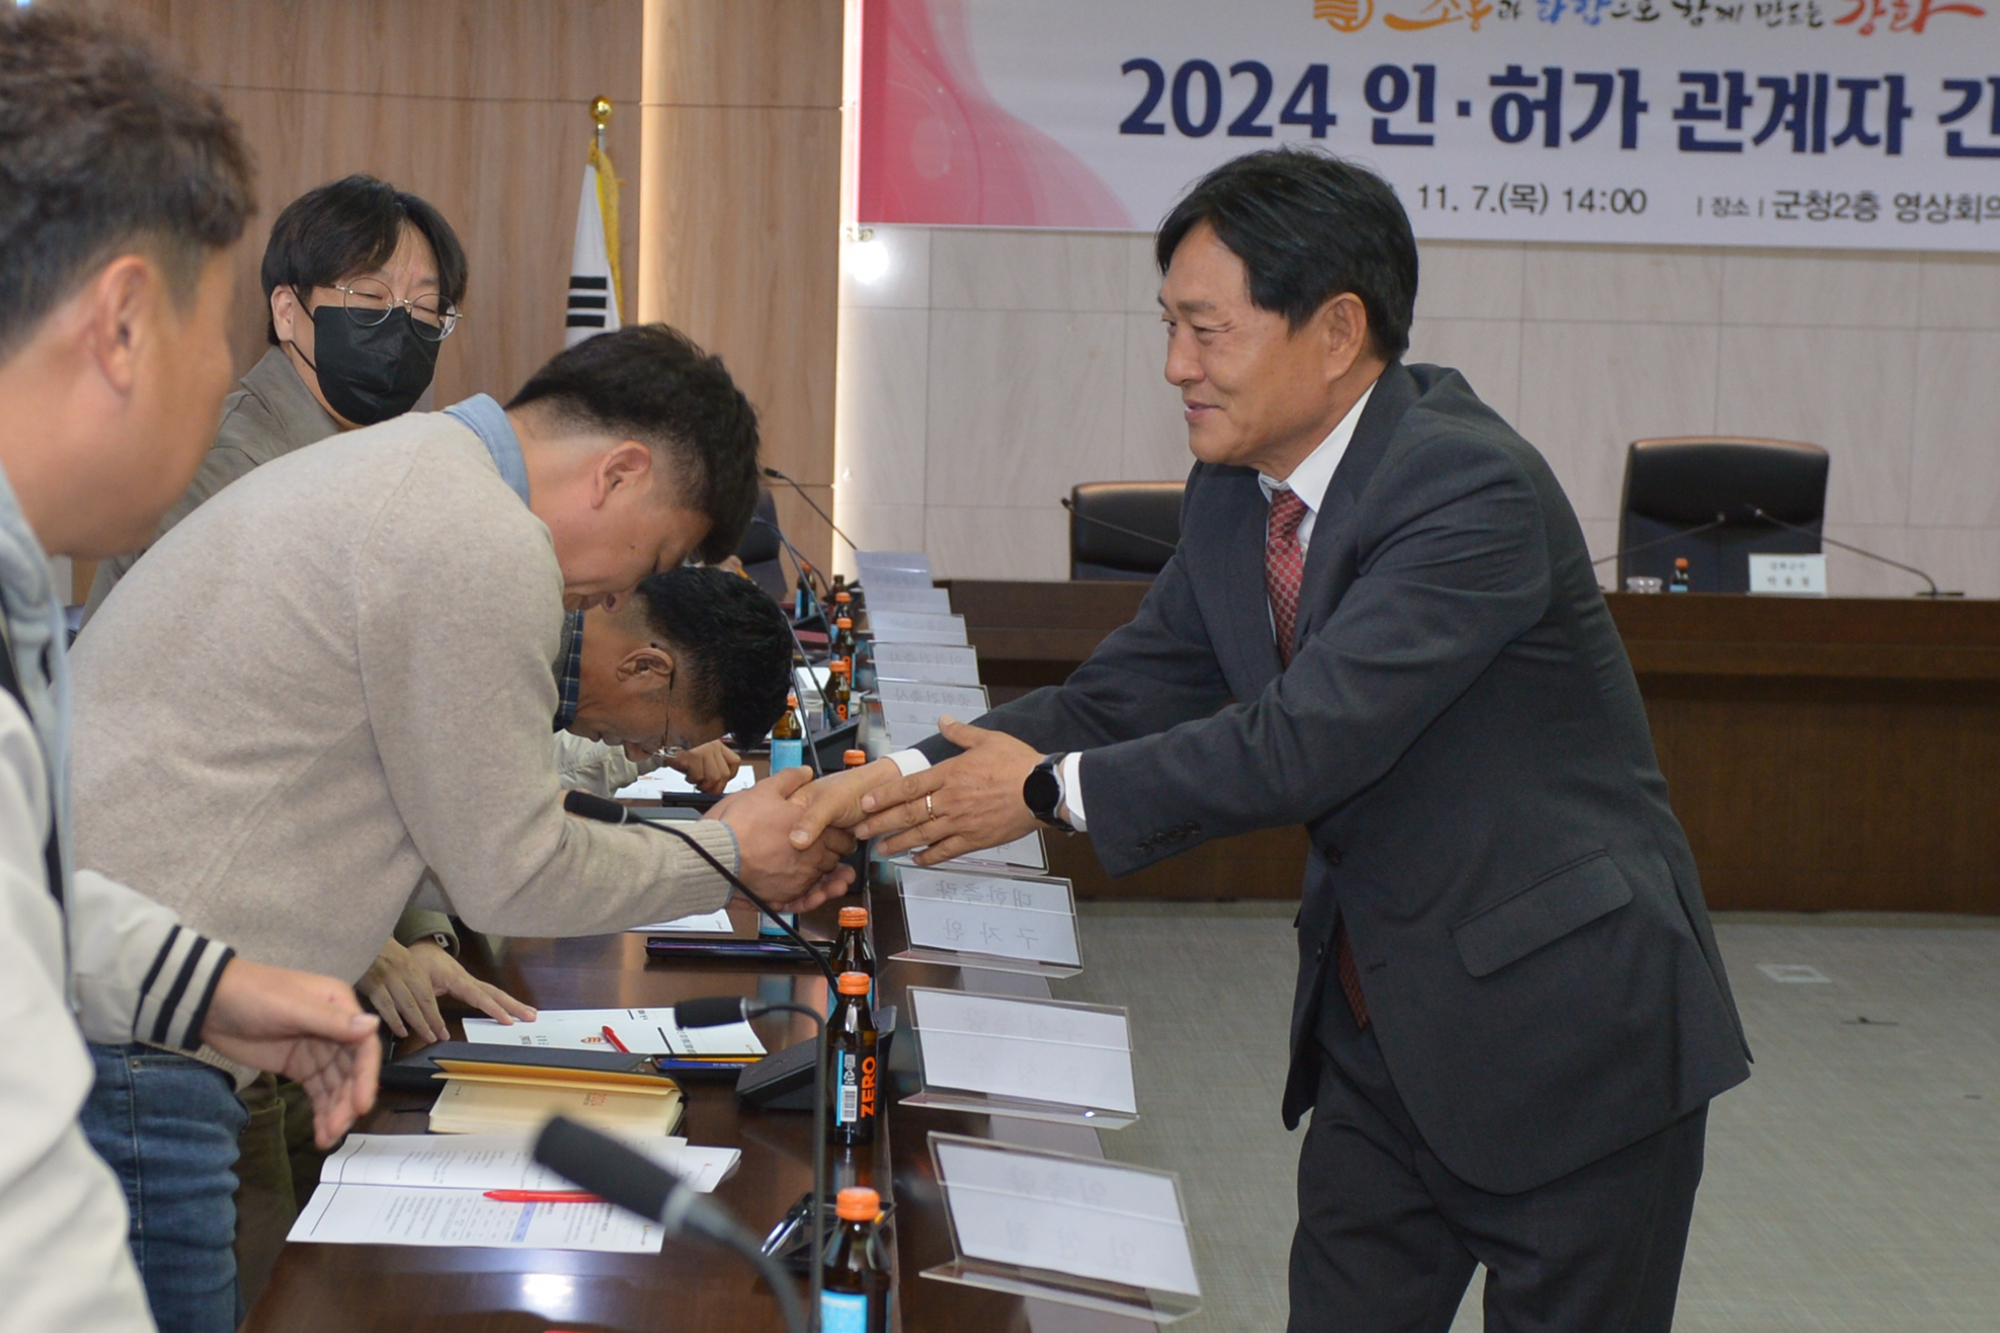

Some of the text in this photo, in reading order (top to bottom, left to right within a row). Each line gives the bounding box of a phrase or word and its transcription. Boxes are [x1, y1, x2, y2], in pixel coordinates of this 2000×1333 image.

[1119, 58, 2000, 157] 2024 인·허가 관계자 간
[1562, 187, 1647, 214] 14:00
[1772, 189, 1880, 222] 군청2층
[861, 1056, 876, 1118] ZERO
